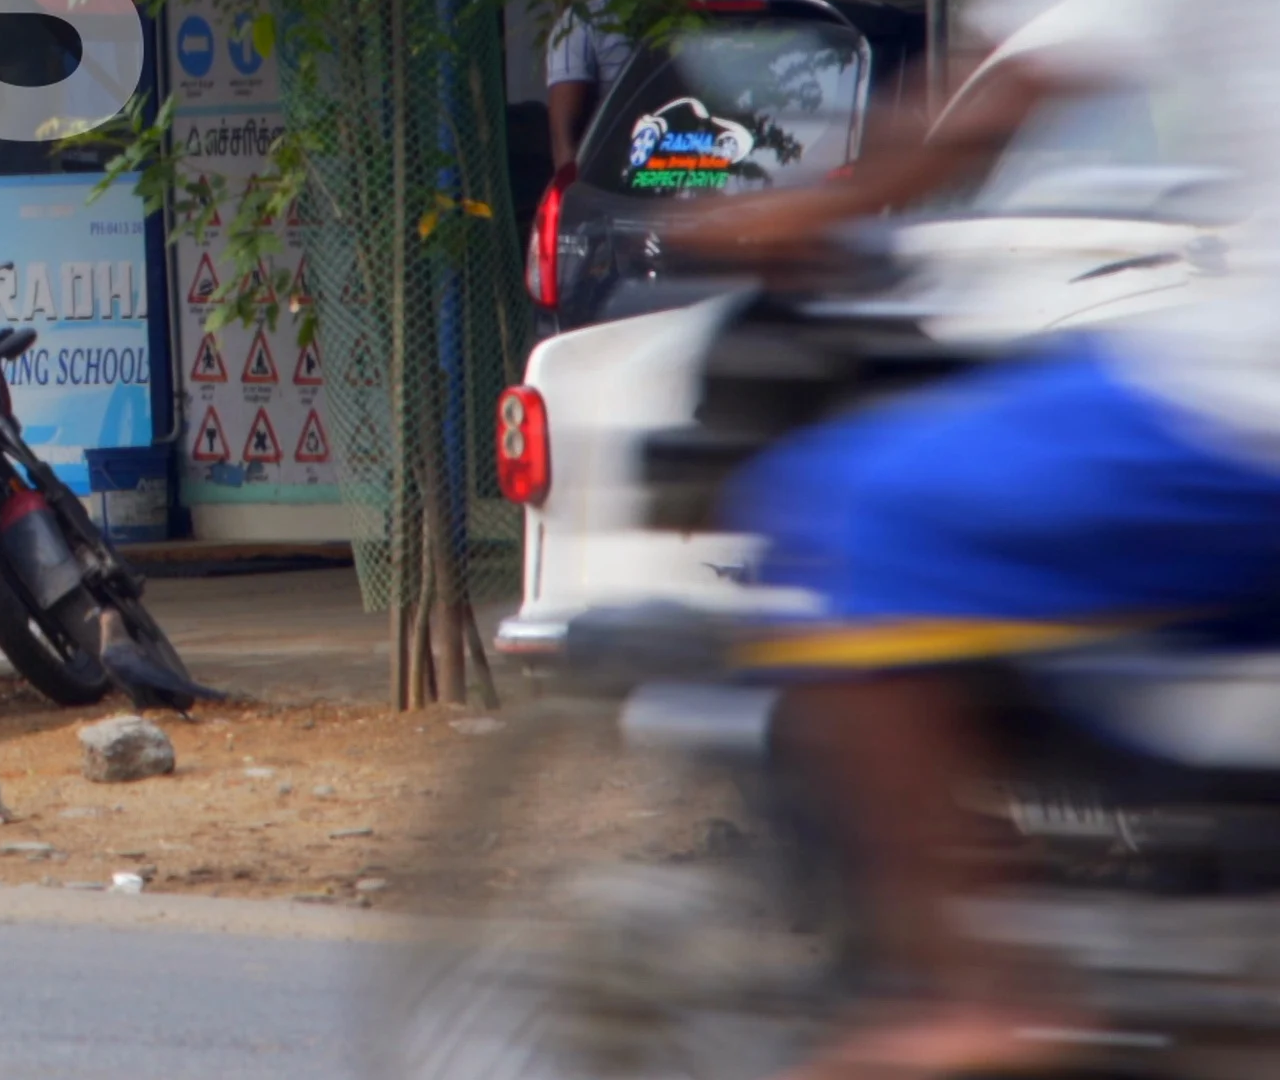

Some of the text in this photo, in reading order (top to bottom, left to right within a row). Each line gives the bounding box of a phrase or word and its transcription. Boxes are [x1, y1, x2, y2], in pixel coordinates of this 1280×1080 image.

[660, 130, 714, 152] RADHA
[632, 169, 731, 188] PERFECT DRIVE
[56, 346, 150, 387] SCHOOL
